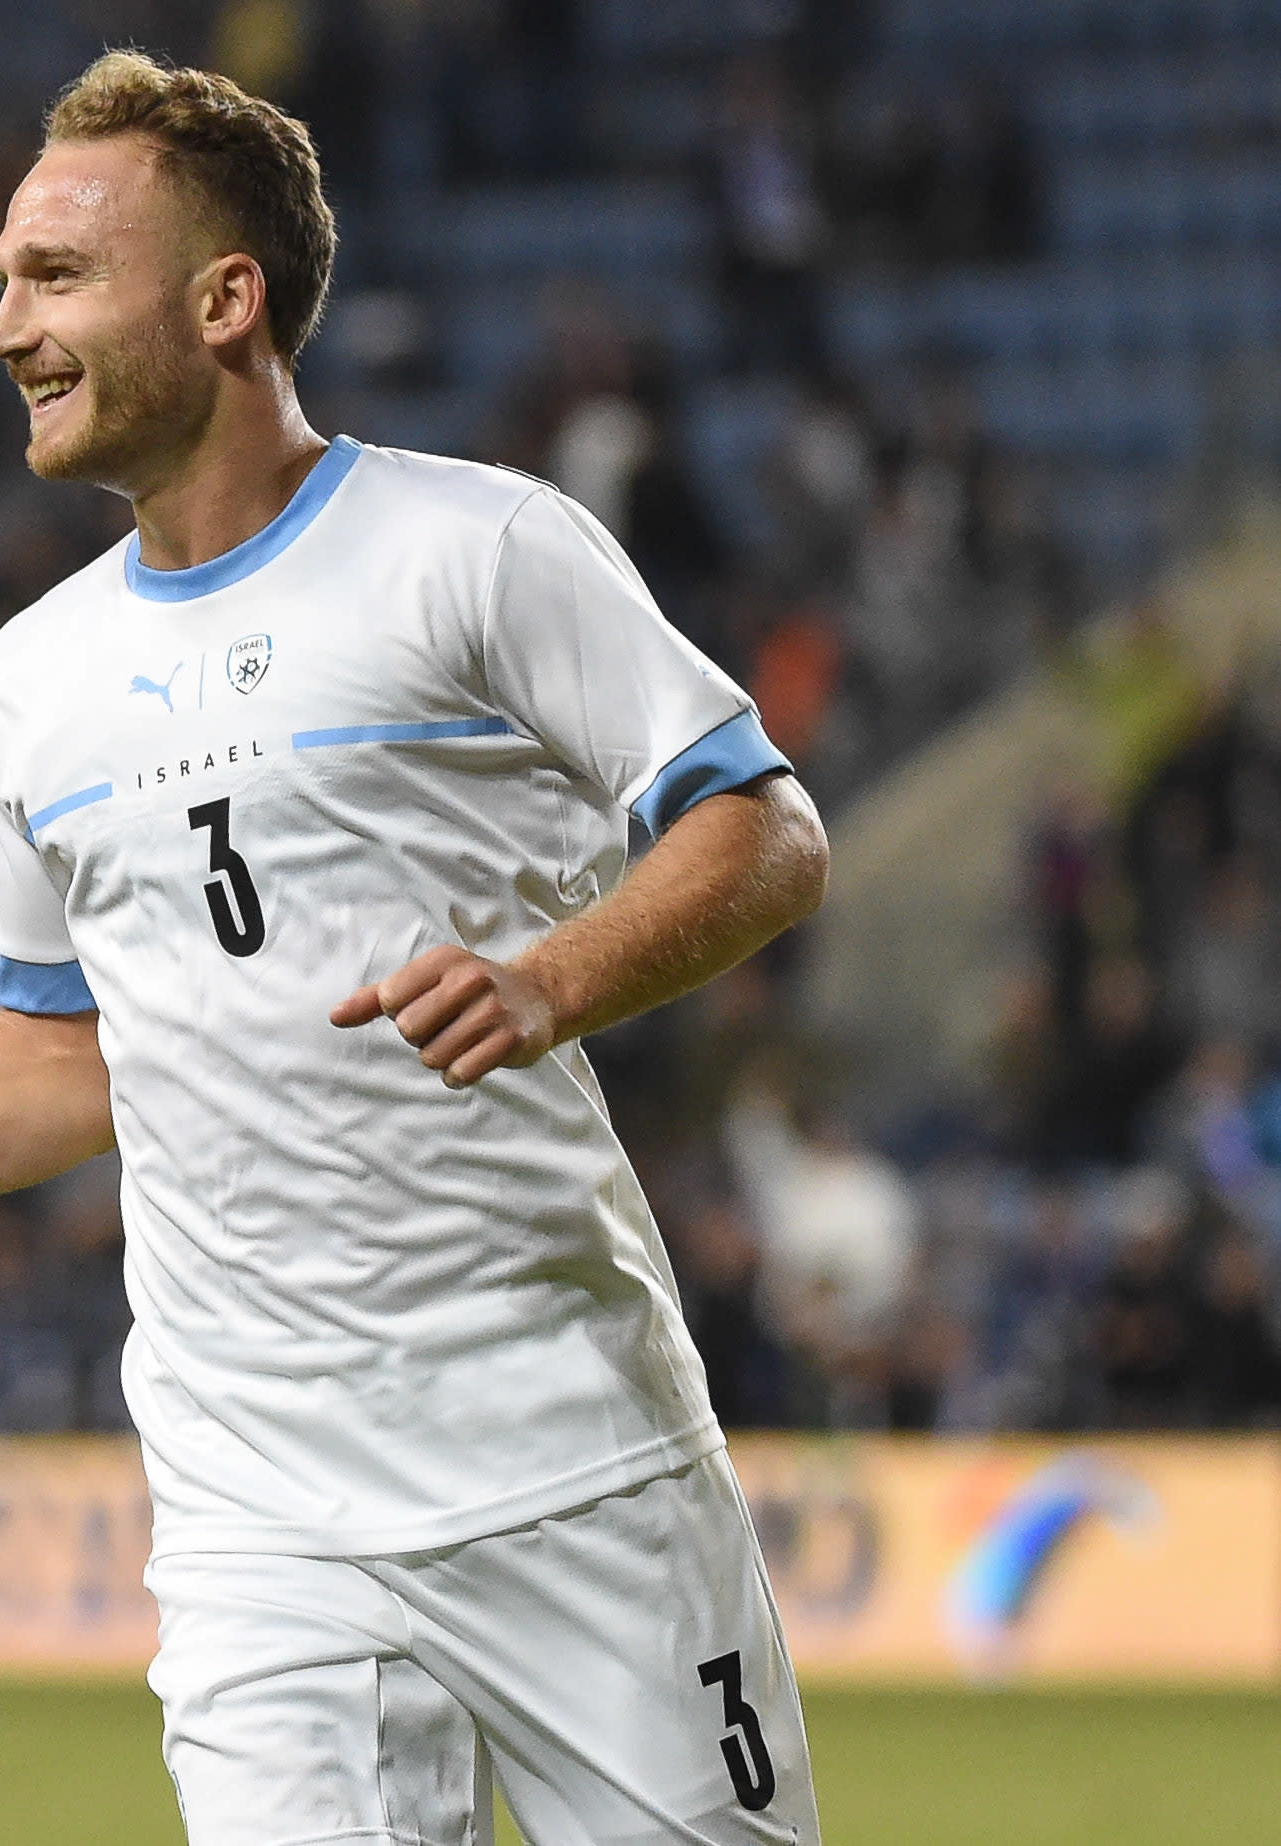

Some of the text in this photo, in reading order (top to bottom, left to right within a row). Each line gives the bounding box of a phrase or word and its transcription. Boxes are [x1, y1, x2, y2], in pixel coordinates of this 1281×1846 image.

[234, 639, 264, 653] ISRAEL
[137, 740, 263, 789] ISRAEL
[187, 796, 266, 958] 3
[697, 1650, 775, 1811] 3
